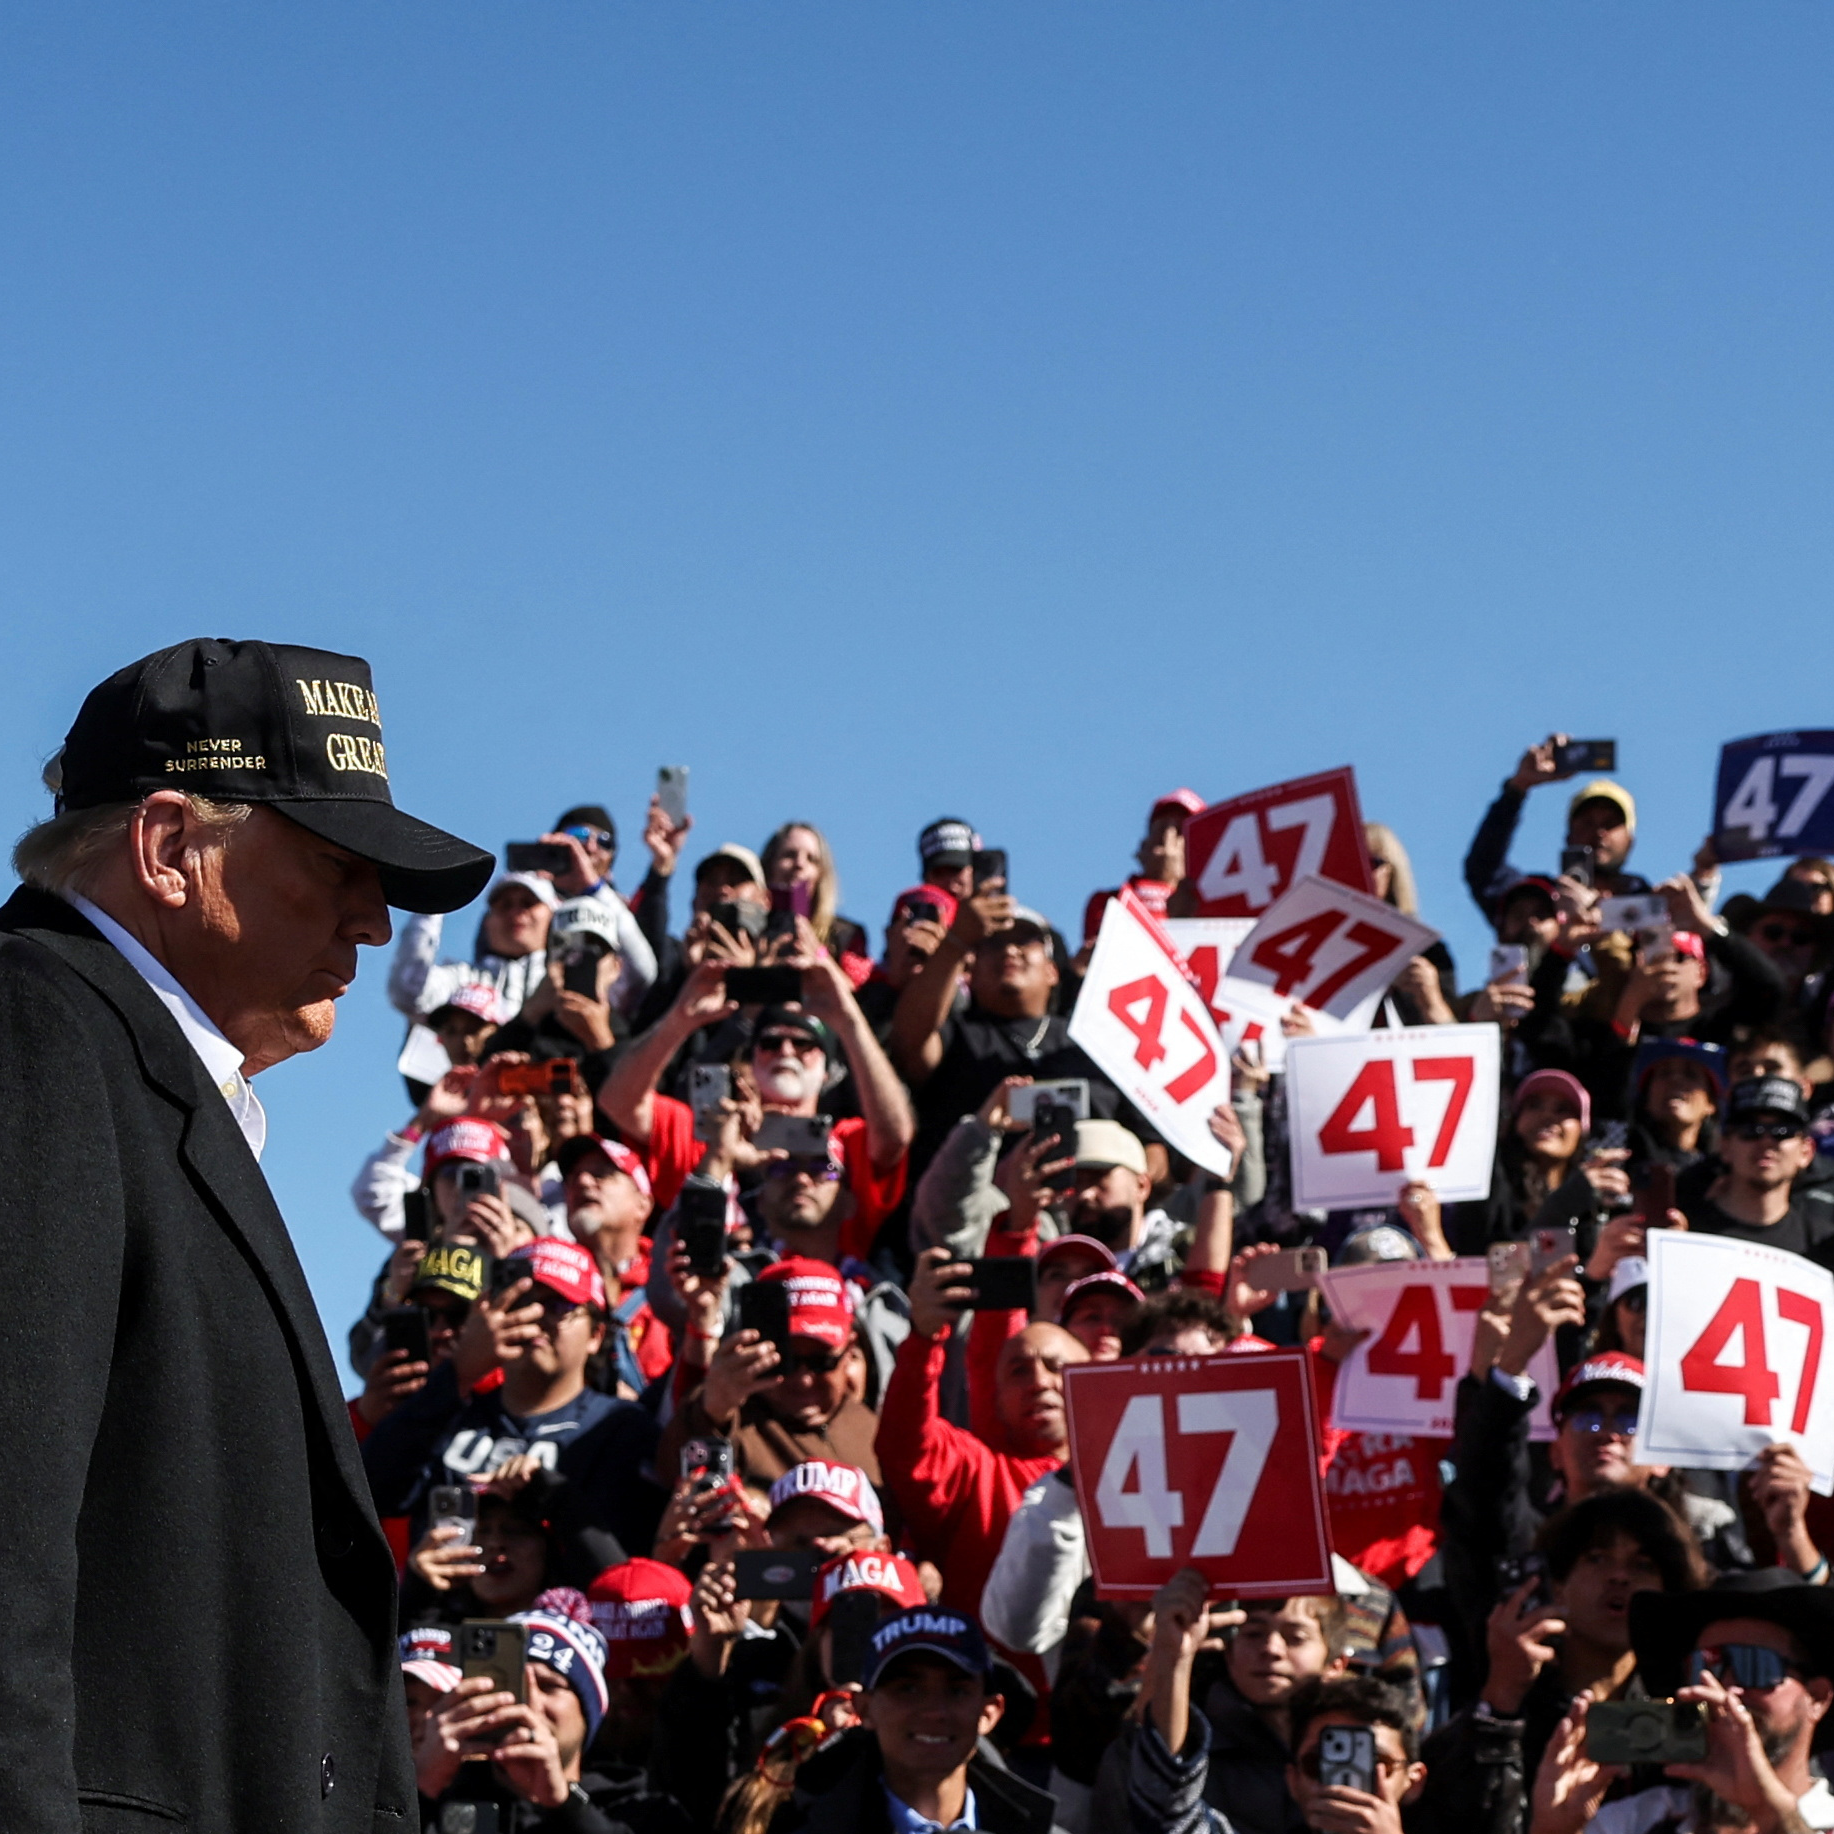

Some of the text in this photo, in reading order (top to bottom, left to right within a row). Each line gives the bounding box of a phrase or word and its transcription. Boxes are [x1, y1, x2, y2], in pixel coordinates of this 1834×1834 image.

[296, 679, 370, 721] MAKE
[165, 756, 266, 772] SURRENDER
[187, 739, 242, 753] NEVER
[1197, 793, 1336, 908] 47
[1251, 909, 1405, 1010] 47
[1108, 974, 1218, 1105] 47
[1319, 1056, 1474, 1172] 47
[1680, 1277, 1824, 1435] 47
[443, 1429, 558, 1474] USA
[1097, 1389, 1280, 1560] 47
[528, 1632, 575, 1676] 24
[870, 1612, 967, 1652] TRUMP
